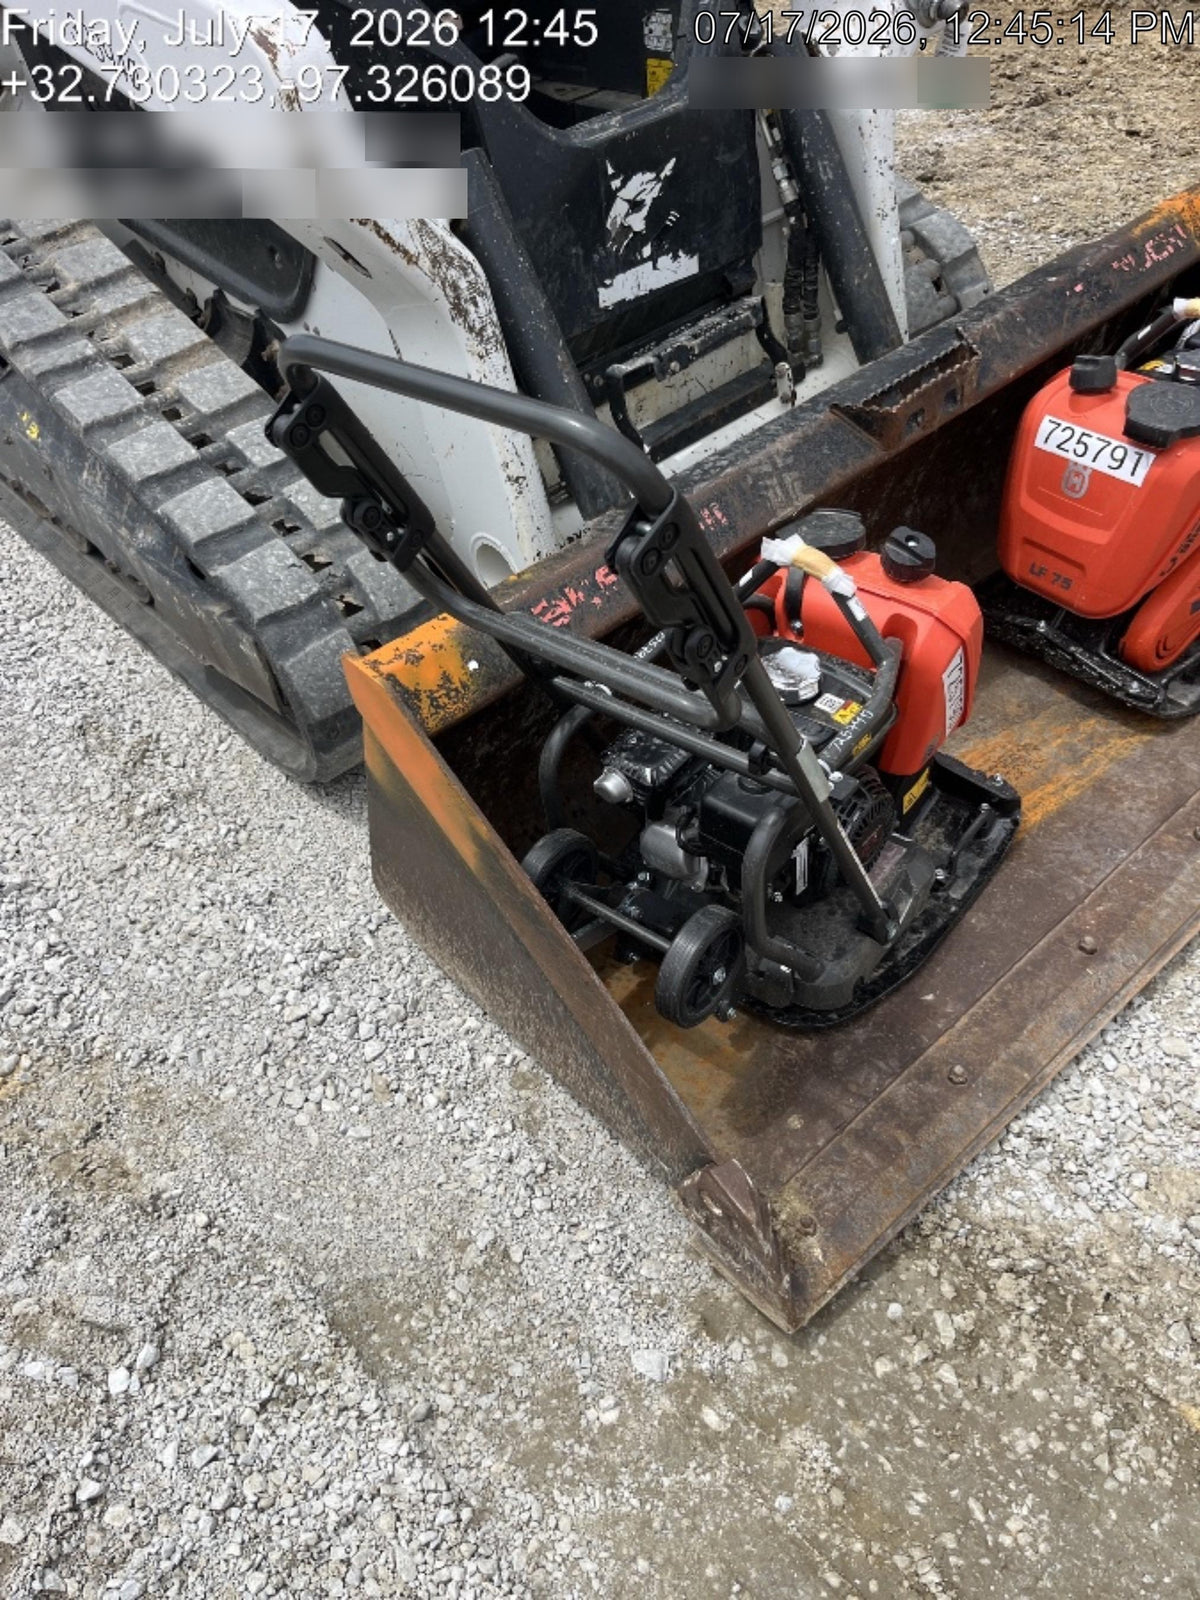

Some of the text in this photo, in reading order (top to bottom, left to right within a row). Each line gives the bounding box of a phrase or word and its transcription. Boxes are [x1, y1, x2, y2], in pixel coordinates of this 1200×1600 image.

[1043, 418, 1145, 478] 725791
[1029, 561, 1073, 591] LF 75
